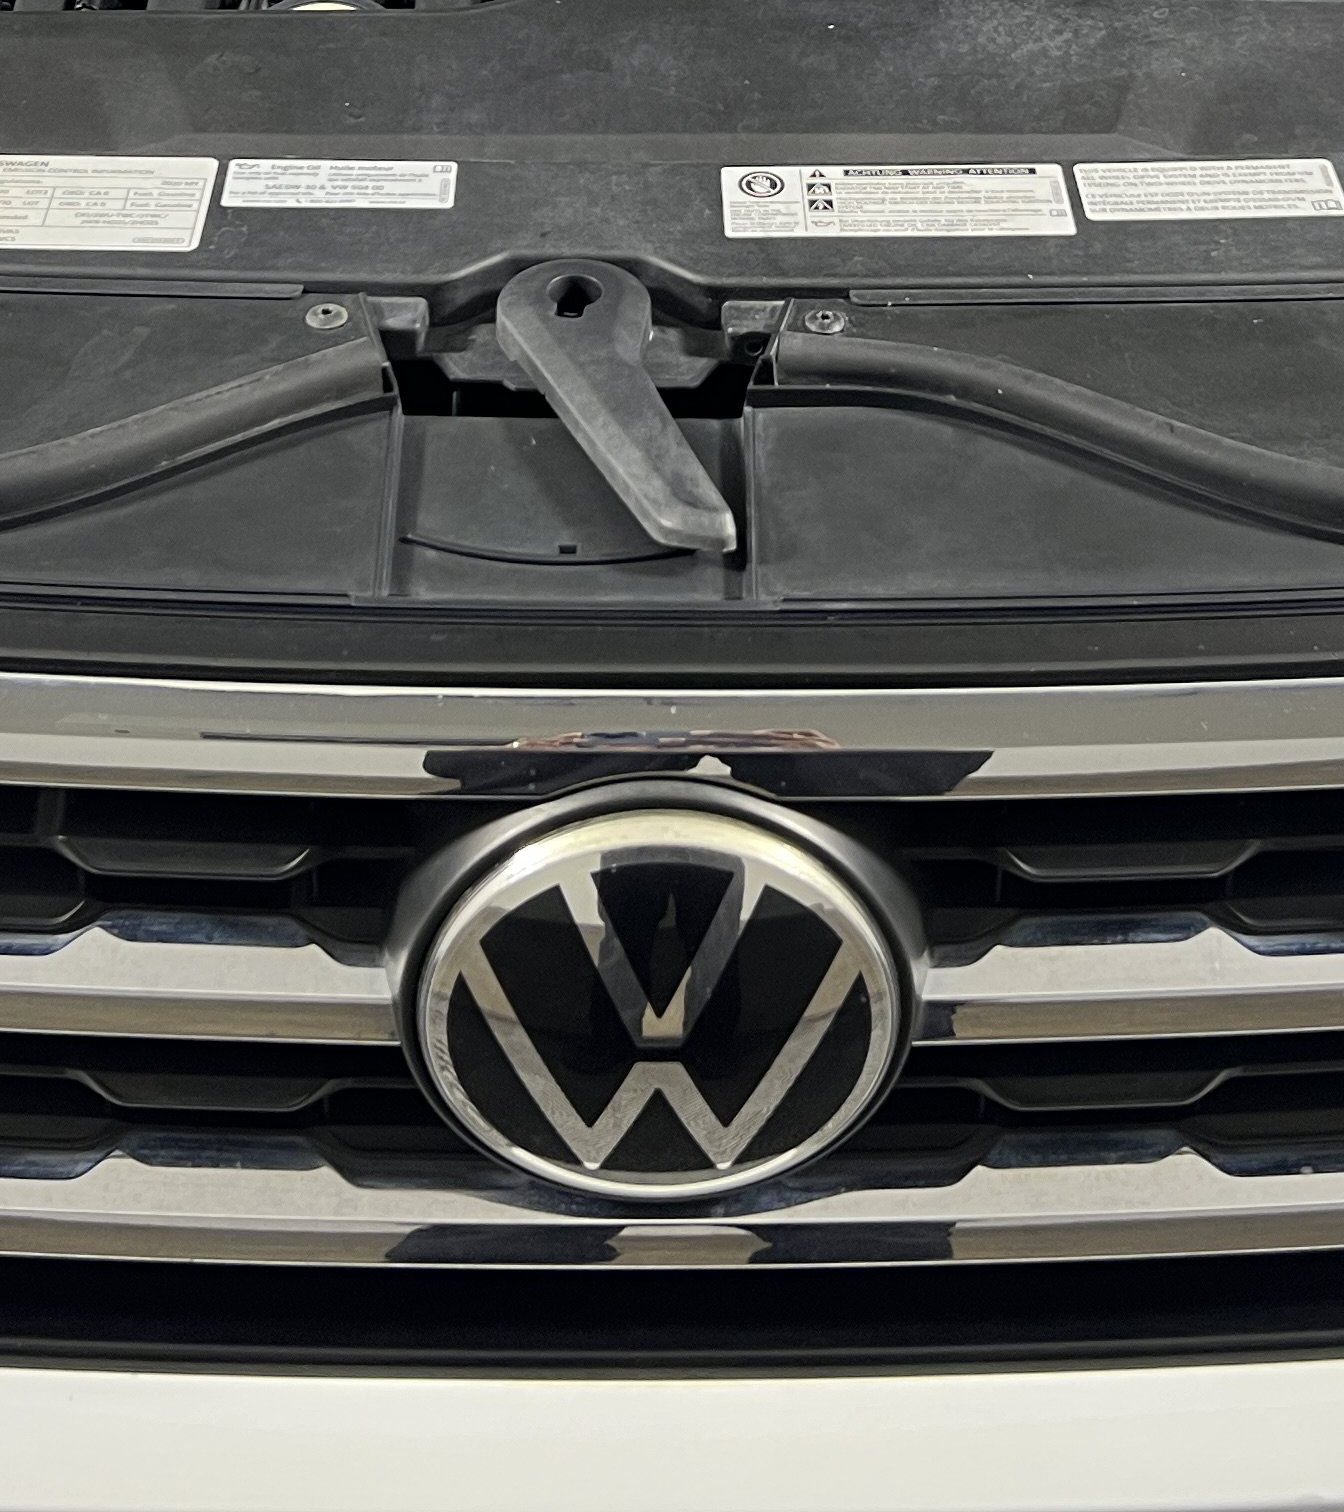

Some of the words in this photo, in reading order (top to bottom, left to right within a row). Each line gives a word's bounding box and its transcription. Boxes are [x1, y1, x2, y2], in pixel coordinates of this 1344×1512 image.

[909, 168, 963, 176] WARNING
[968, 167, 1030, 175] ATTENTION
[451, 840, 872, 1176] VW
